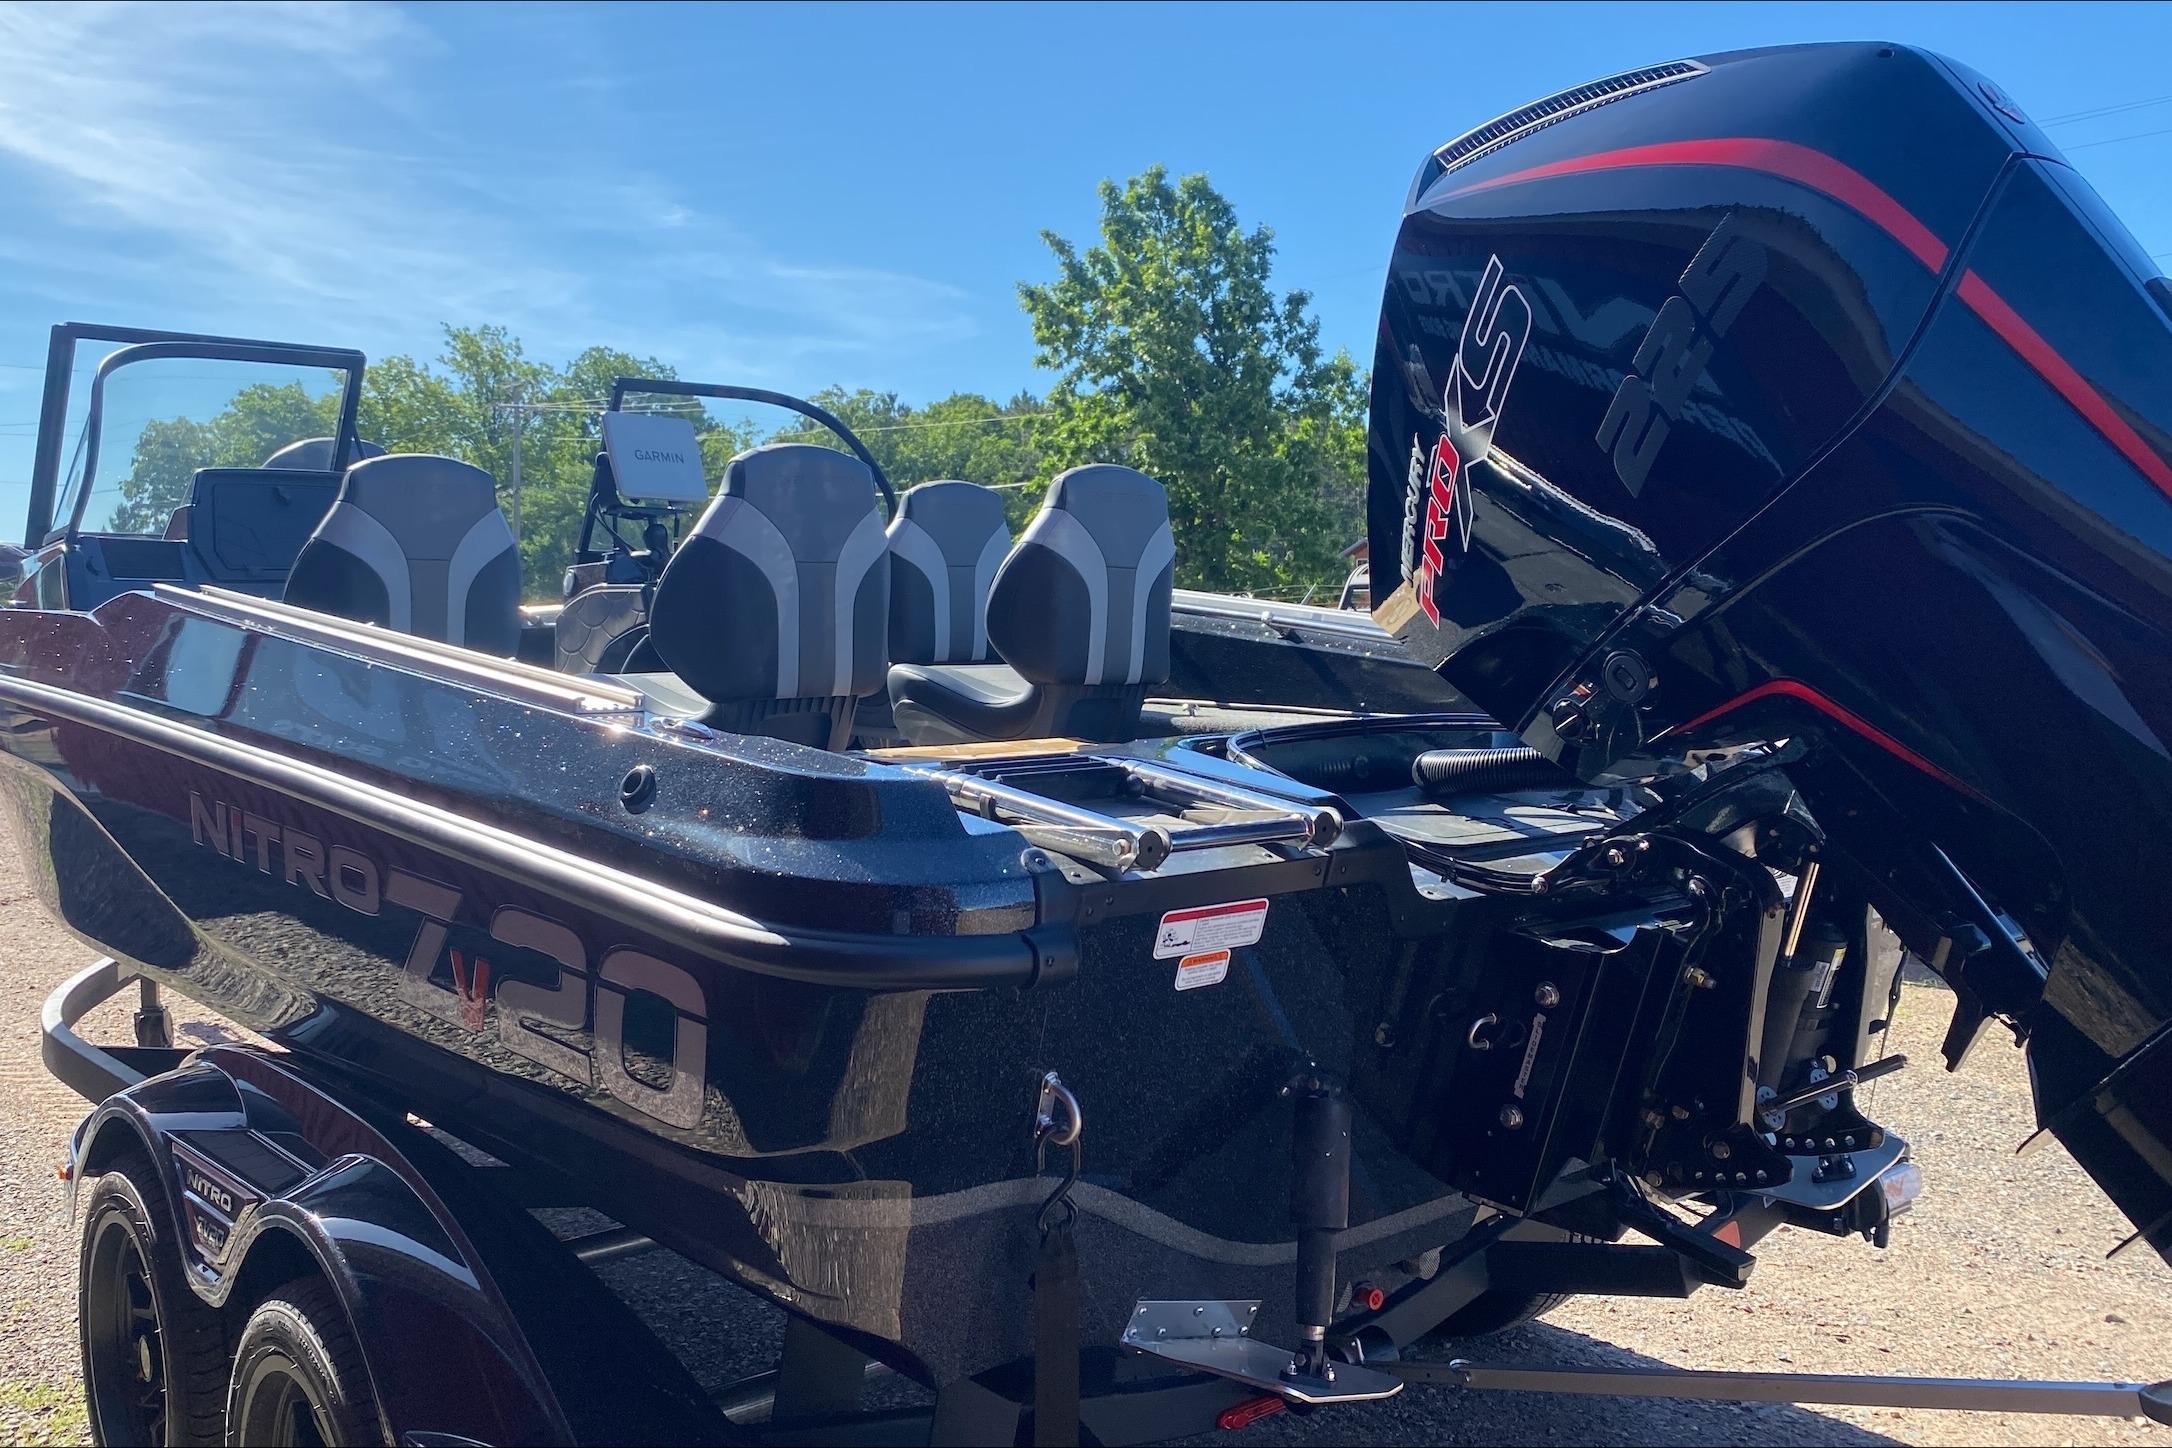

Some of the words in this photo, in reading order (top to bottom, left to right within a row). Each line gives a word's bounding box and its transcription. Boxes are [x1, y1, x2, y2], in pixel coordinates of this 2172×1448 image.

[1594, 211, 1769, 499] 225
[633, 448, 685, 464] GARMIN
[1400, 431, 1426, 589] MERCURY
[1419, 433, 1461, 631] PRO
[189, 789, 382, 917] NITRO
[186, 1168, 232, 1213] NITRO
